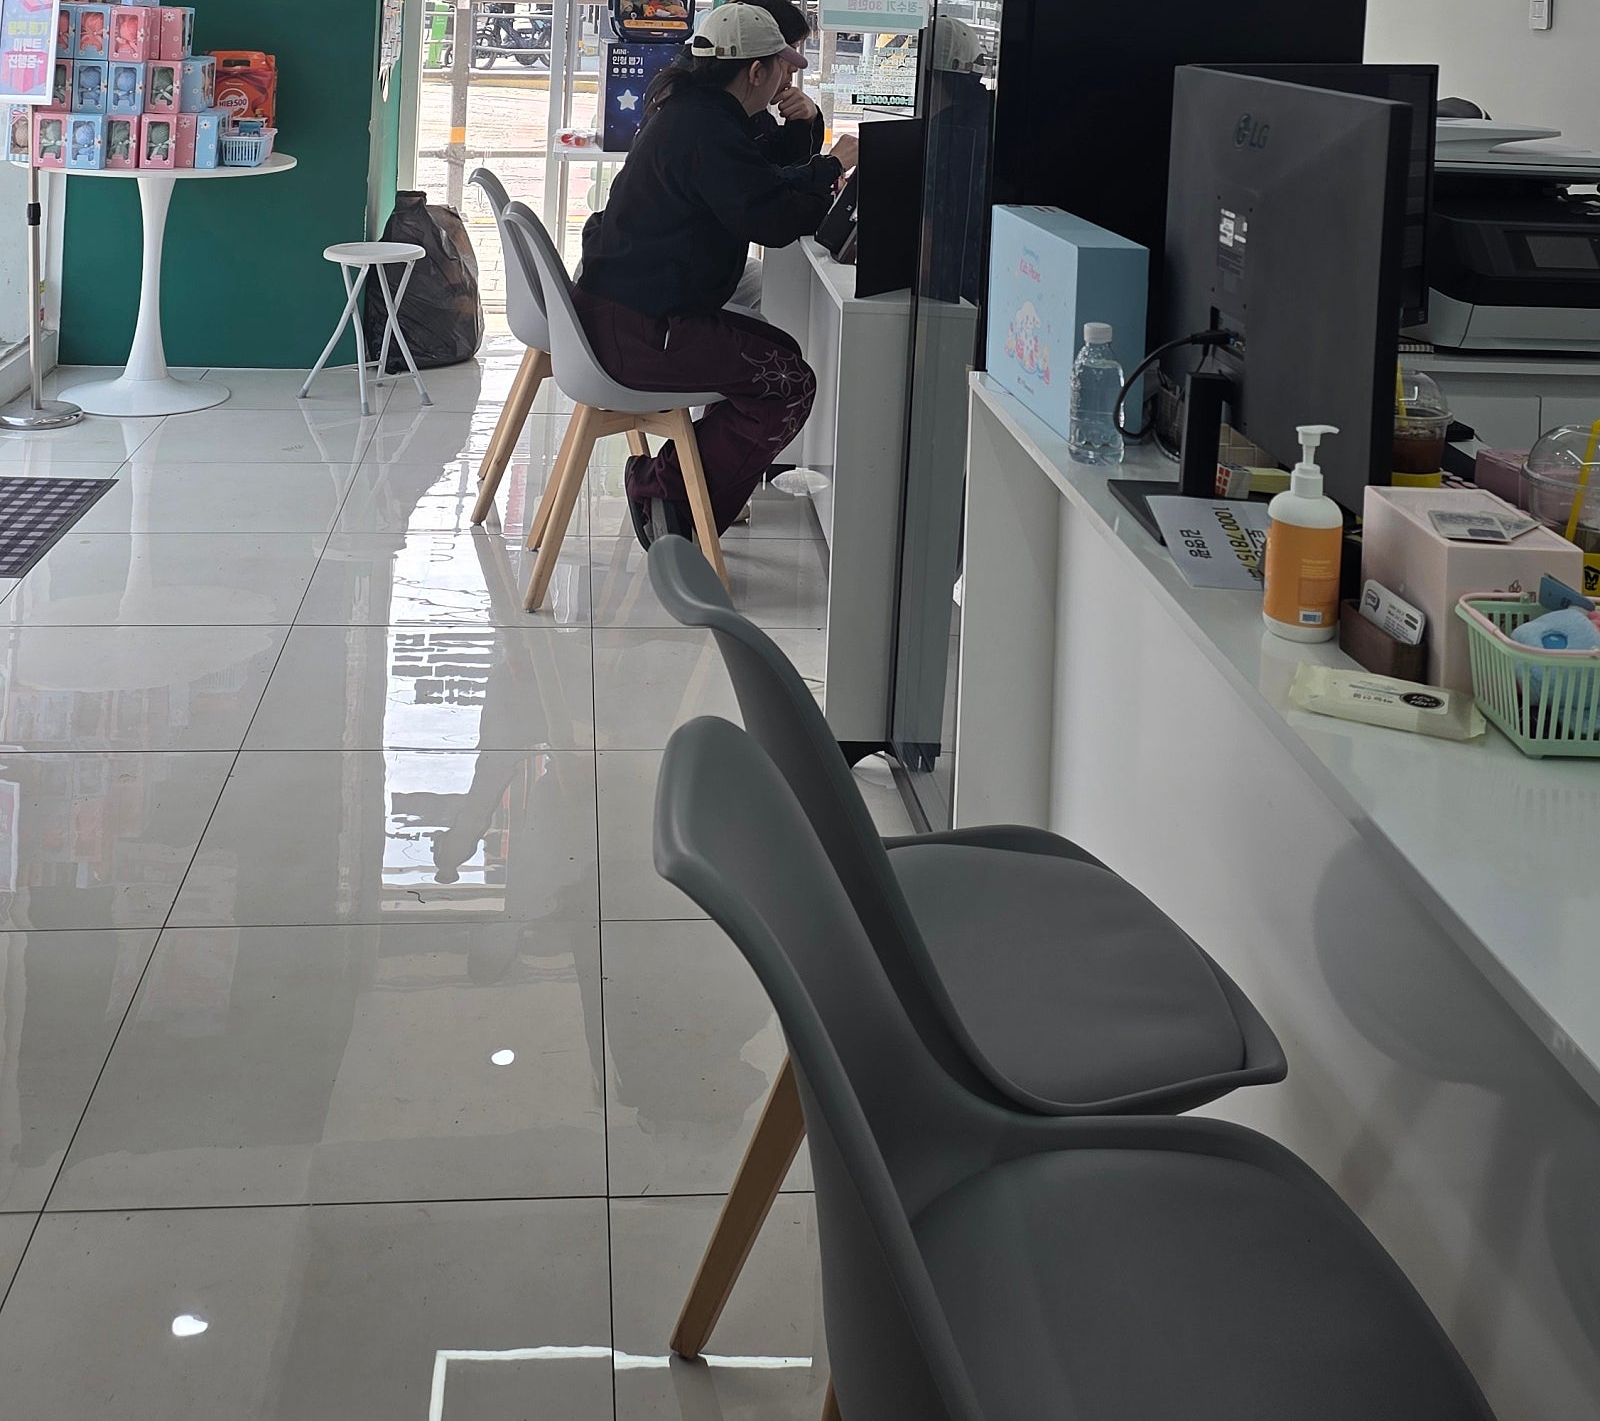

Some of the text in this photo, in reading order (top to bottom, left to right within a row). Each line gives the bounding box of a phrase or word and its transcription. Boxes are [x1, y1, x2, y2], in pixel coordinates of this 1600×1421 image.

[14, 38, 42, 51] 이벤트
[612, 56, 643, 66] 인형 뽑기
[1180, 529, 1212, 559] 김영광
[1212, 506, 1252, 563] 1000 7815
